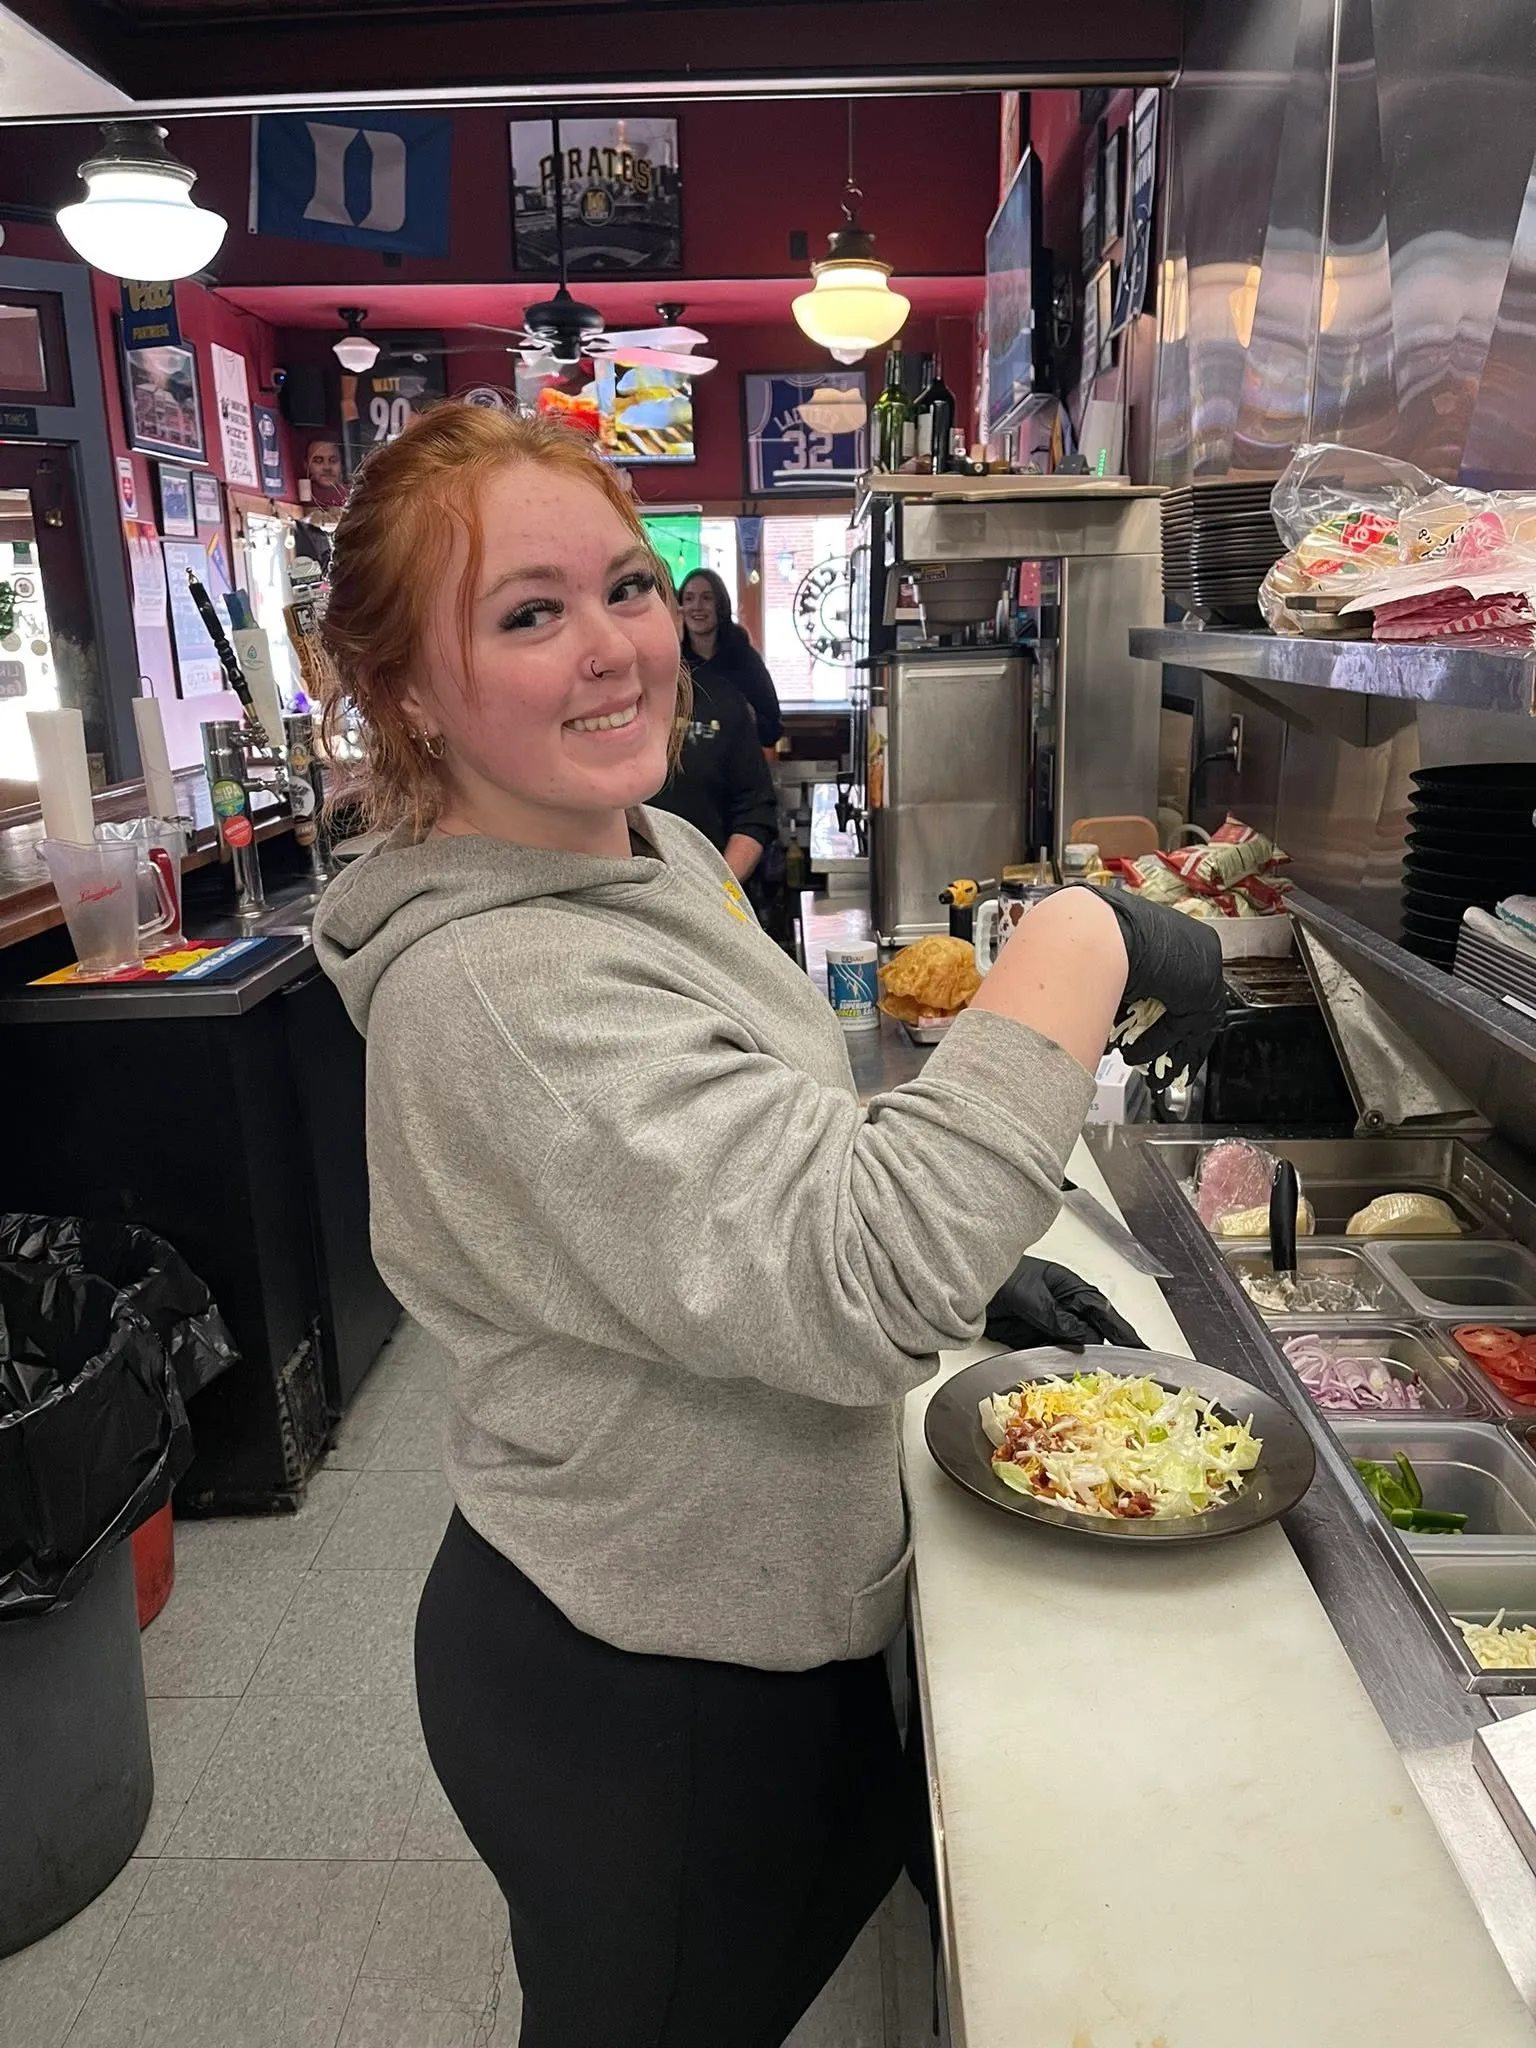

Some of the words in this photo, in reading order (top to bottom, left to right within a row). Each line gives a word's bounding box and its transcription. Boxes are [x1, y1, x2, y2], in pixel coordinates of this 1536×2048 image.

[303, 121, 407, 233] D
[539, 146, 652, 196] PRATES
[370, 396, 411, 441] 90
[782, 430, 834, 470] 32
